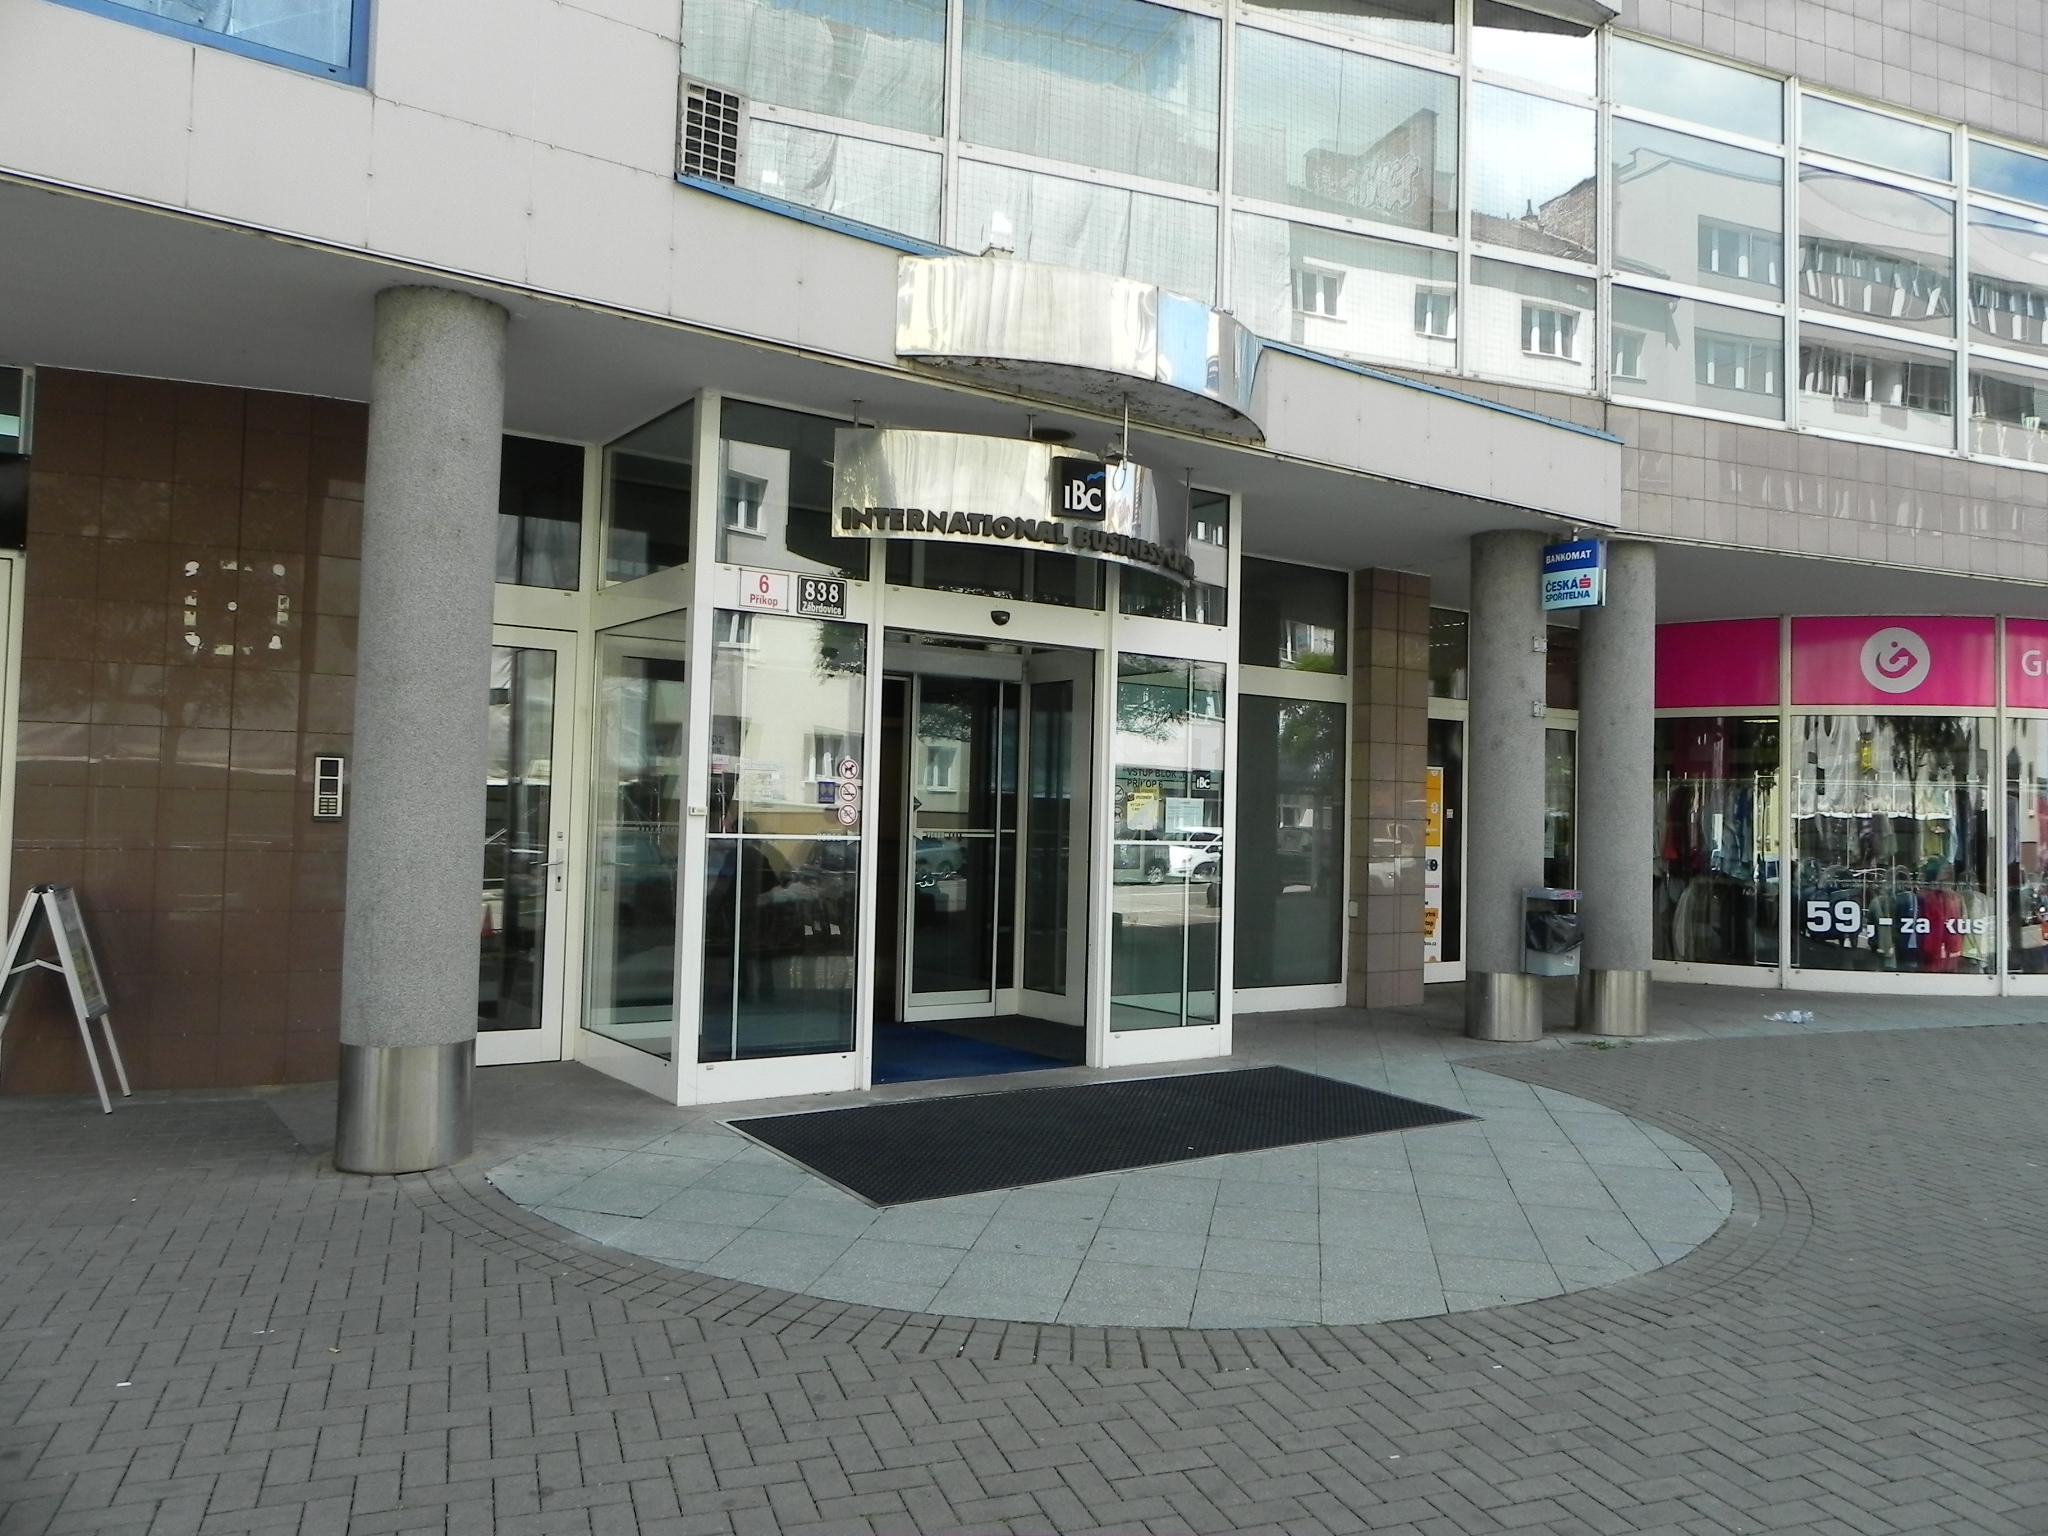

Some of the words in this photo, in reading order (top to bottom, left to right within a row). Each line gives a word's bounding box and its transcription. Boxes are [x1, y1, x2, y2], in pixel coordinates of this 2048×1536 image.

[1064, 480, 1103, 512] IBC
[841, 507, 1069, 546] INTERNATIONAL
[1546, 549, 1592, 564] BANKOMAT
[759, 574, 770, 594] 6
[804, 580, 840, 604] 838
[1546, 577, 1578, 592] ČESKÁ
[749, 593, 778, 607] Příkop
[1546, 590, 1590, 602] SPOŘITELNA
[801, 600, 842, 616] Zábrdovice
[2021, 649, 2048, 677] G
[1127, 767, 1152, 777] VSTUP
[1155, 770, 1176, 779] BLOK
[1196, 776, 1211, 789] IBC
[1900, 917, 1931, 934] za
